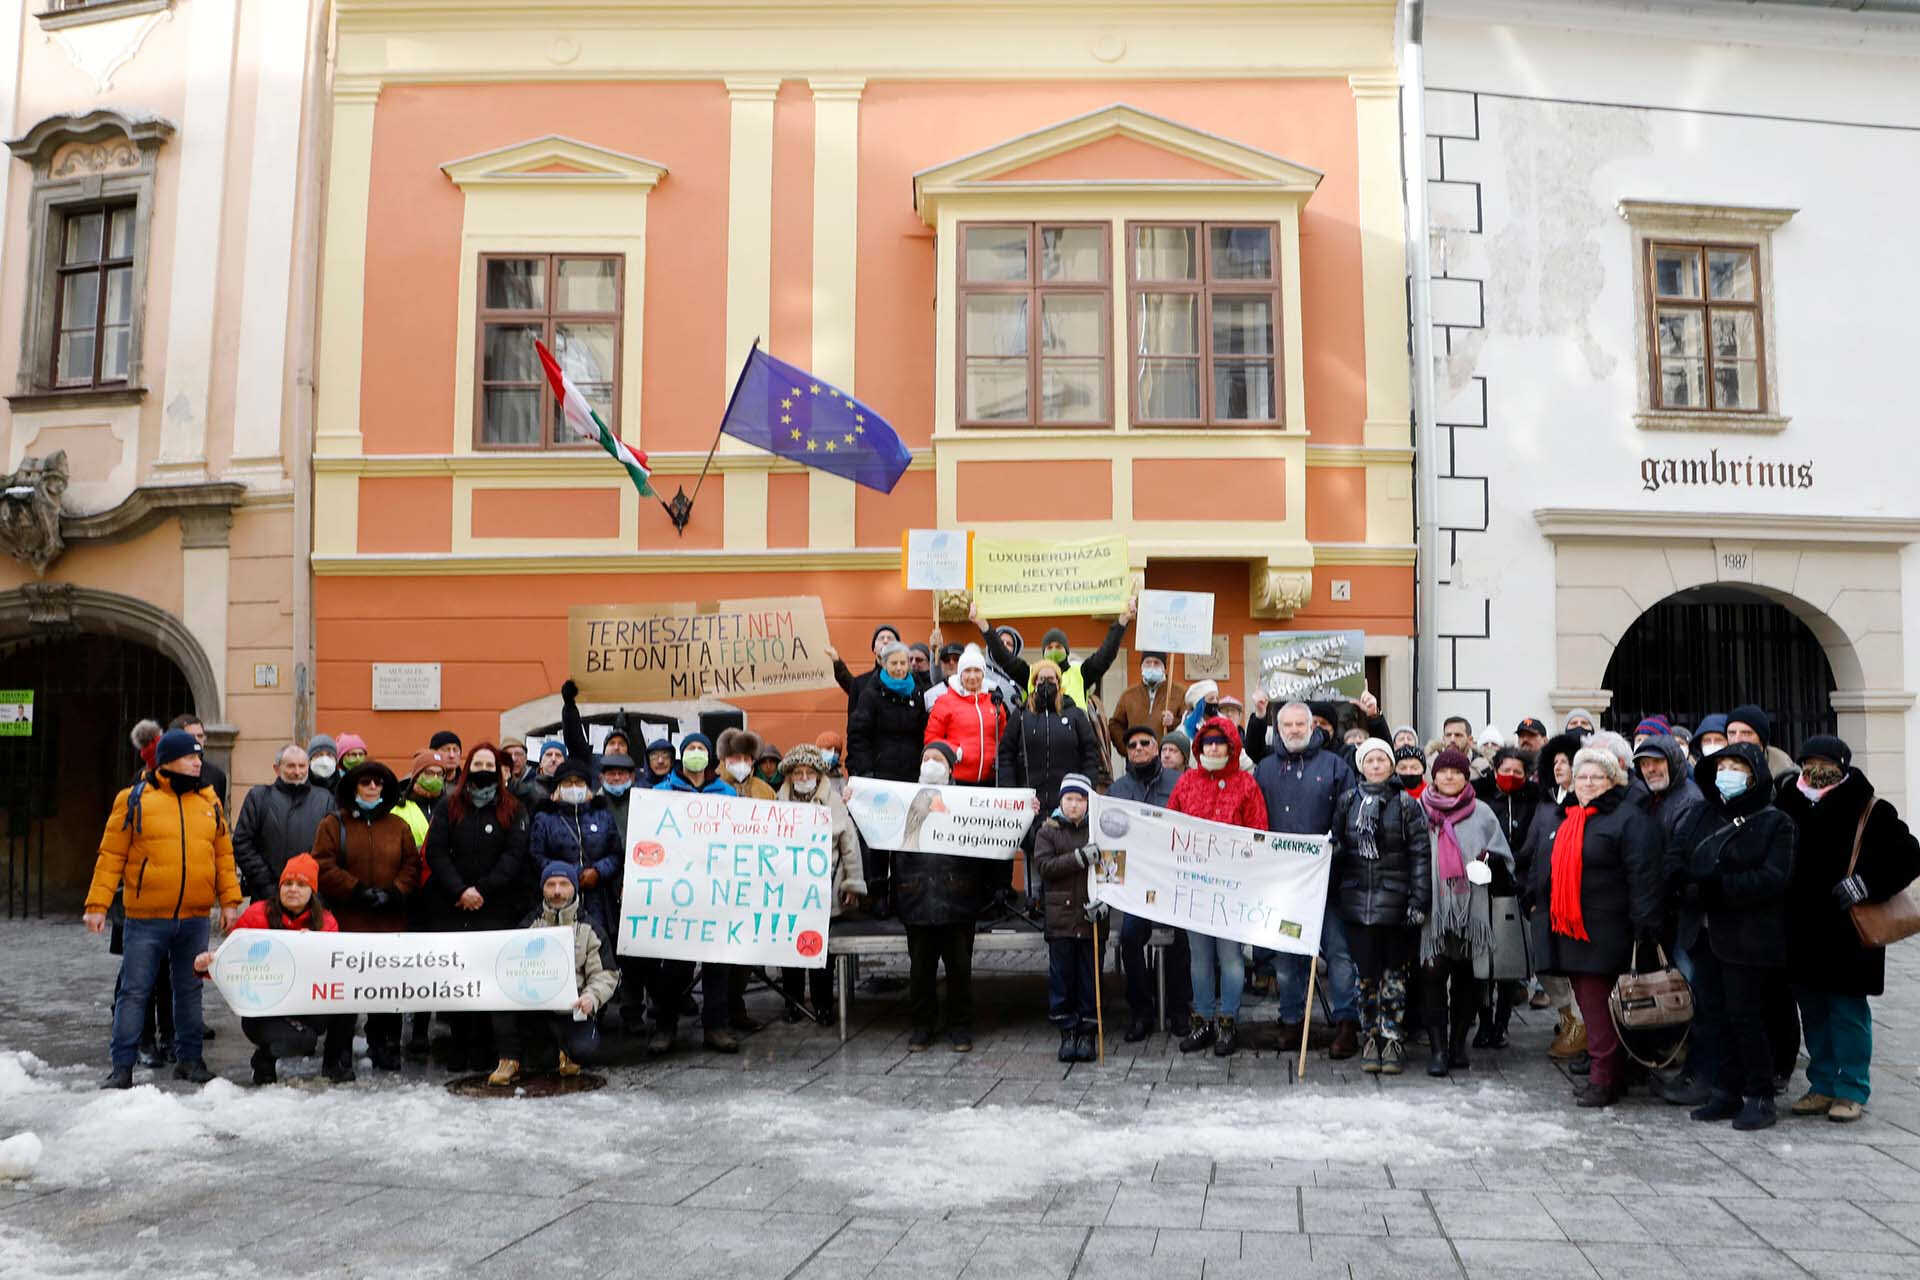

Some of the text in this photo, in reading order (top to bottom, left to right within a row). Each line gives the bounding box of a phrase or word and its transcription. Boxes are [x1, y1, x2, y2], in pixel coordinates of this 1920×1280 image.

[1640, 448, 1814, 492] gambrinus
[988, 546, 1111, 563] LUXUSBERUHÁZÁS
[1723, 553, 1748, 570] 1987
[1022, 567, 1080, 578] HELYETT
[976, 577, 1126, 594] TERMÉSZETVÉDELMET
[749, 611, 795, 640] NEM
[586, 642, 690, 673] BETONT!
[700, 641, 712, 666] A
[791, 637, 809, 660] A
[687, 801, 830, 826] OUR LAKE IS
[969, 797, 1025, 811] Ezt NEM
[656, 808, 682, 838] A
[693, 822, 720, 833] NOT
[732, 823, 769, 835] YOURS
[953, 814, 1023, 831] nyomjátok
[932, 829, 944, 841] le
[947, 832, 955, 841] a
[706, 833, 829, 878] FERTŐ
[1271, 838, 1323, 856] GREENPEACE
[637, 861, 822, 910] TÓ NEM A
[330, 951, 466, 972] Fejlesztést,
[311, 980, 482, 1000] NE rombolást!
